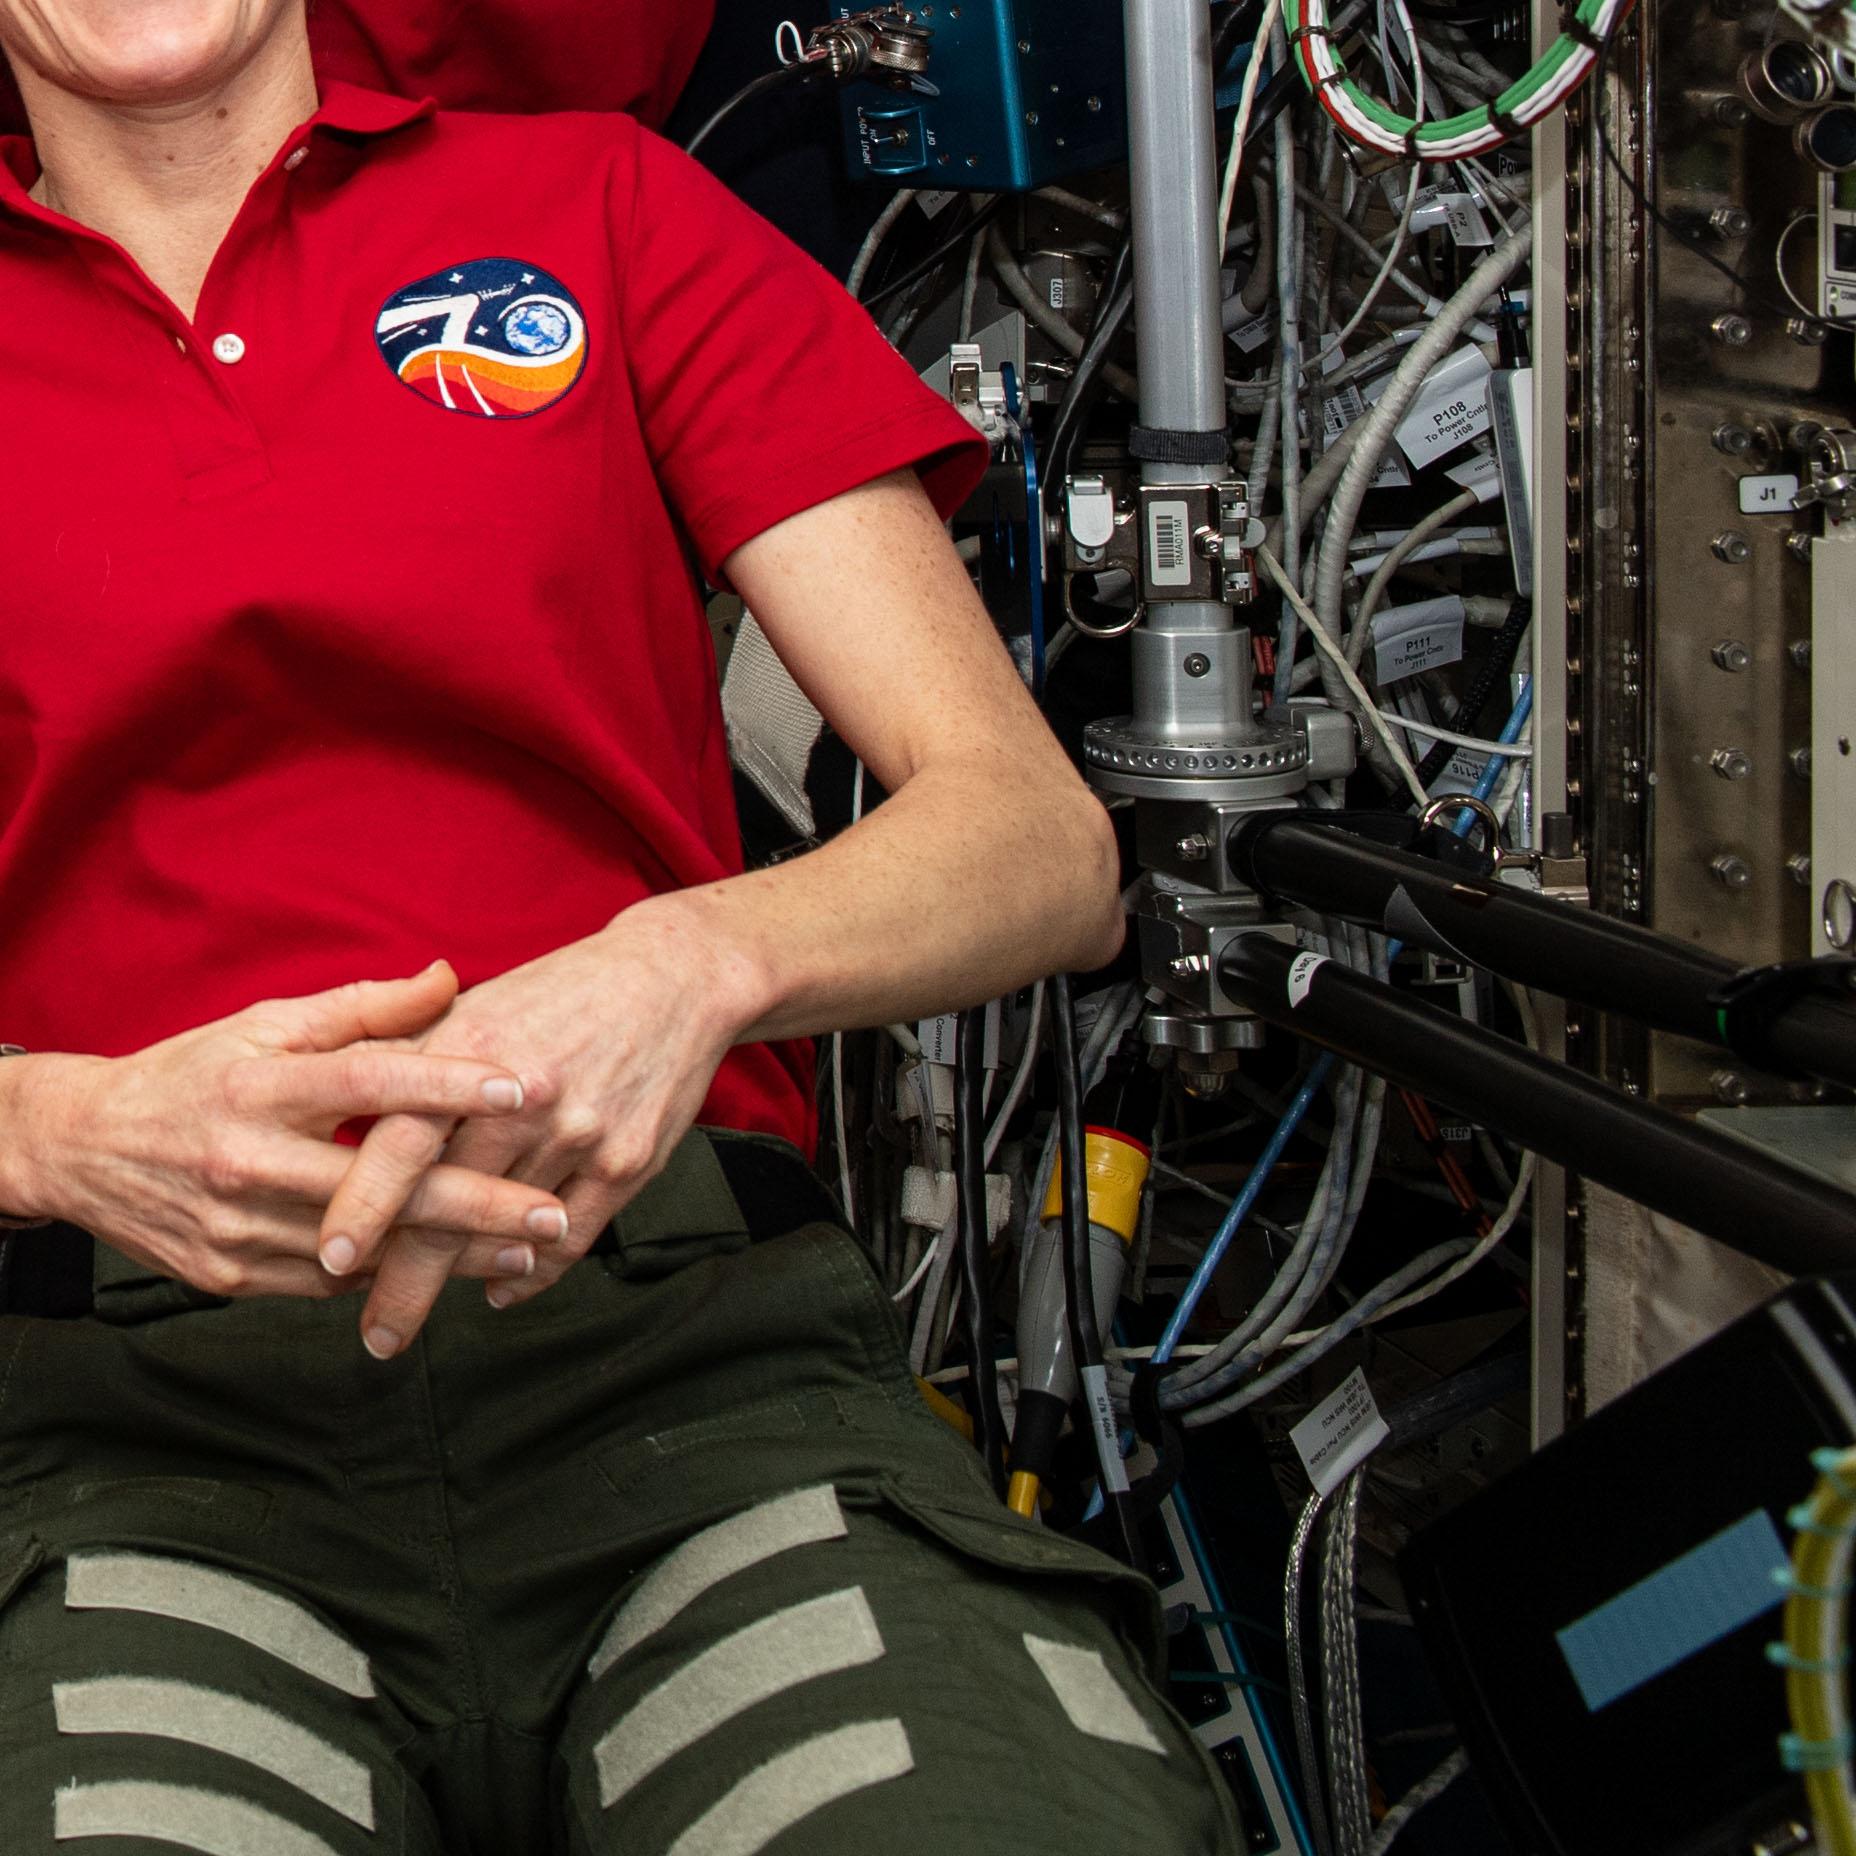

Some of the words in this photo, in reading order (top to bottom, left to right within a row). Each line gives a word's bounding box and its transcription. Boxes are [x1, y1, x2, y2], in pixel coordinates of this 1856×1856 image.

[927, 129, 936, 145] OFF
[1455, 211, 1467, 227] P2
[1051, 280, 1061, 304] J307
[1433, 400, 1467, 427] P108
[1424, 432, 1437, 445] To
[1438, 416, 1466, 438] Power
[1452, 423, 1474, 441] J108
[1760, 488, 1776, 500] J1
[1174, 519, 1185, 565] RMA011M
[1405, 636, 1431, 652] P111
[1404, 650, 1425, 663] Power
[934, 1018, 944, 1060] Converter
